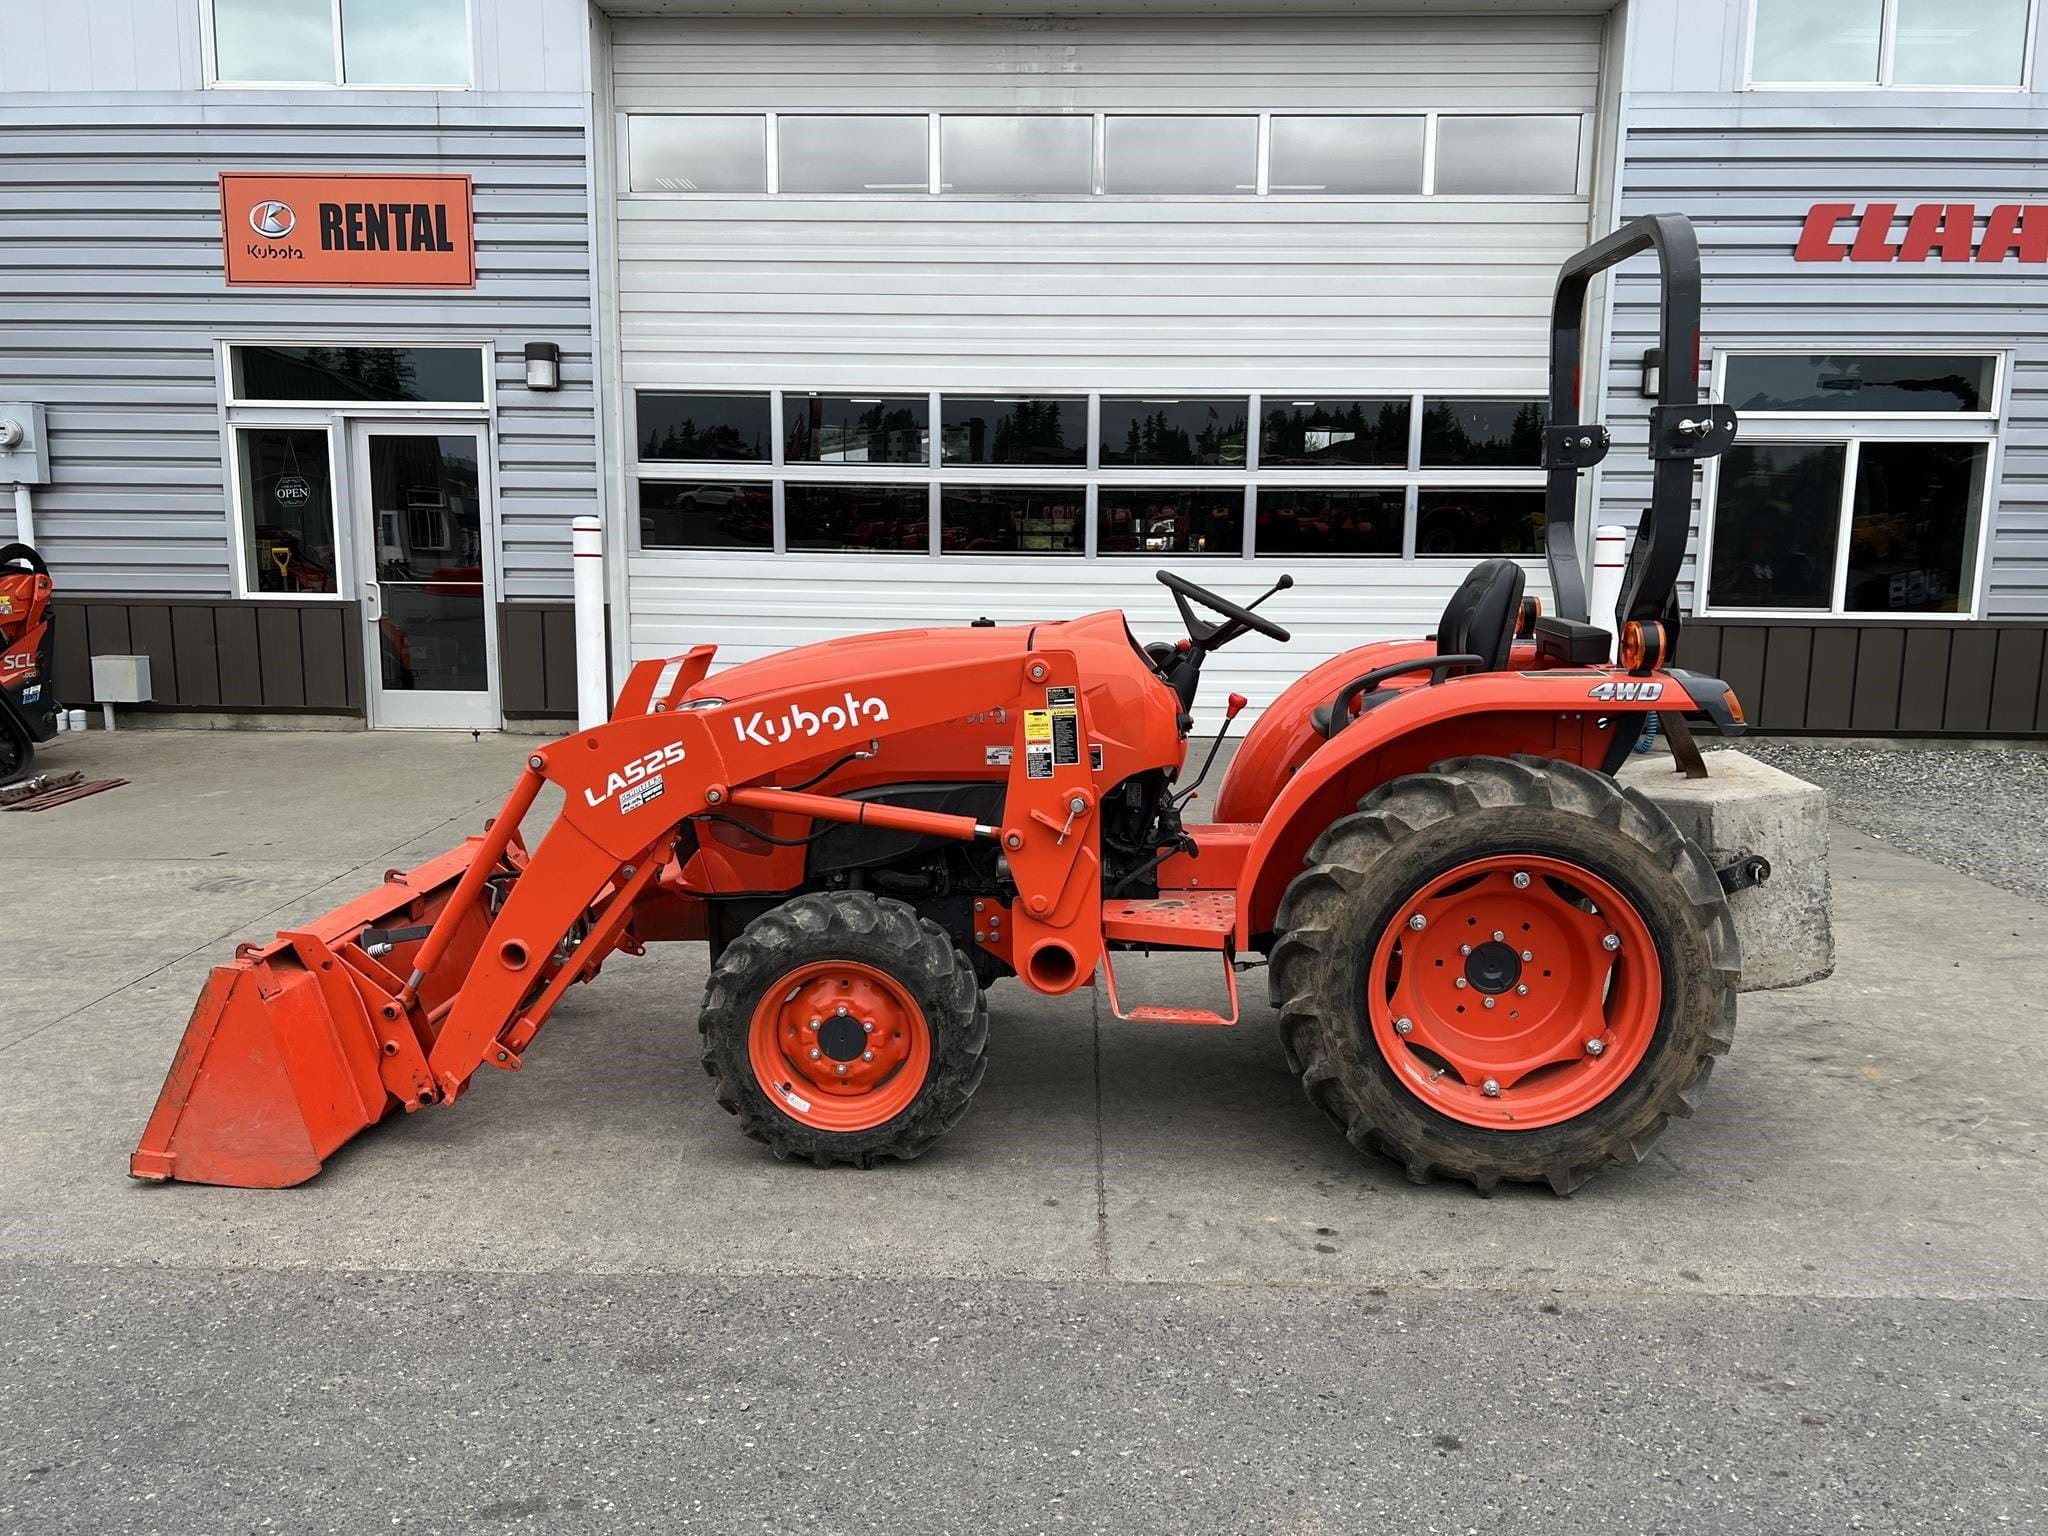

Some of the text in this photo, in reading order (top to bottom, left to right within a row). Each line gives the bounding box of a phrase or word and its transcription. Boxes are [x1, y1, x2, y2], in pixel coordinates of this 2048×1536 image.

[319, 203, 454, 252] RENTAL
[247, 244, 303, 260] Kubota
[277, 488, 308, 498] OPEN
[4, 653, 36, 670] SCL
[1588, 682, 1664, 701] 4WD
[733, 693, 889, 746] Kubota
[584, 741, 685, 807] LA525
